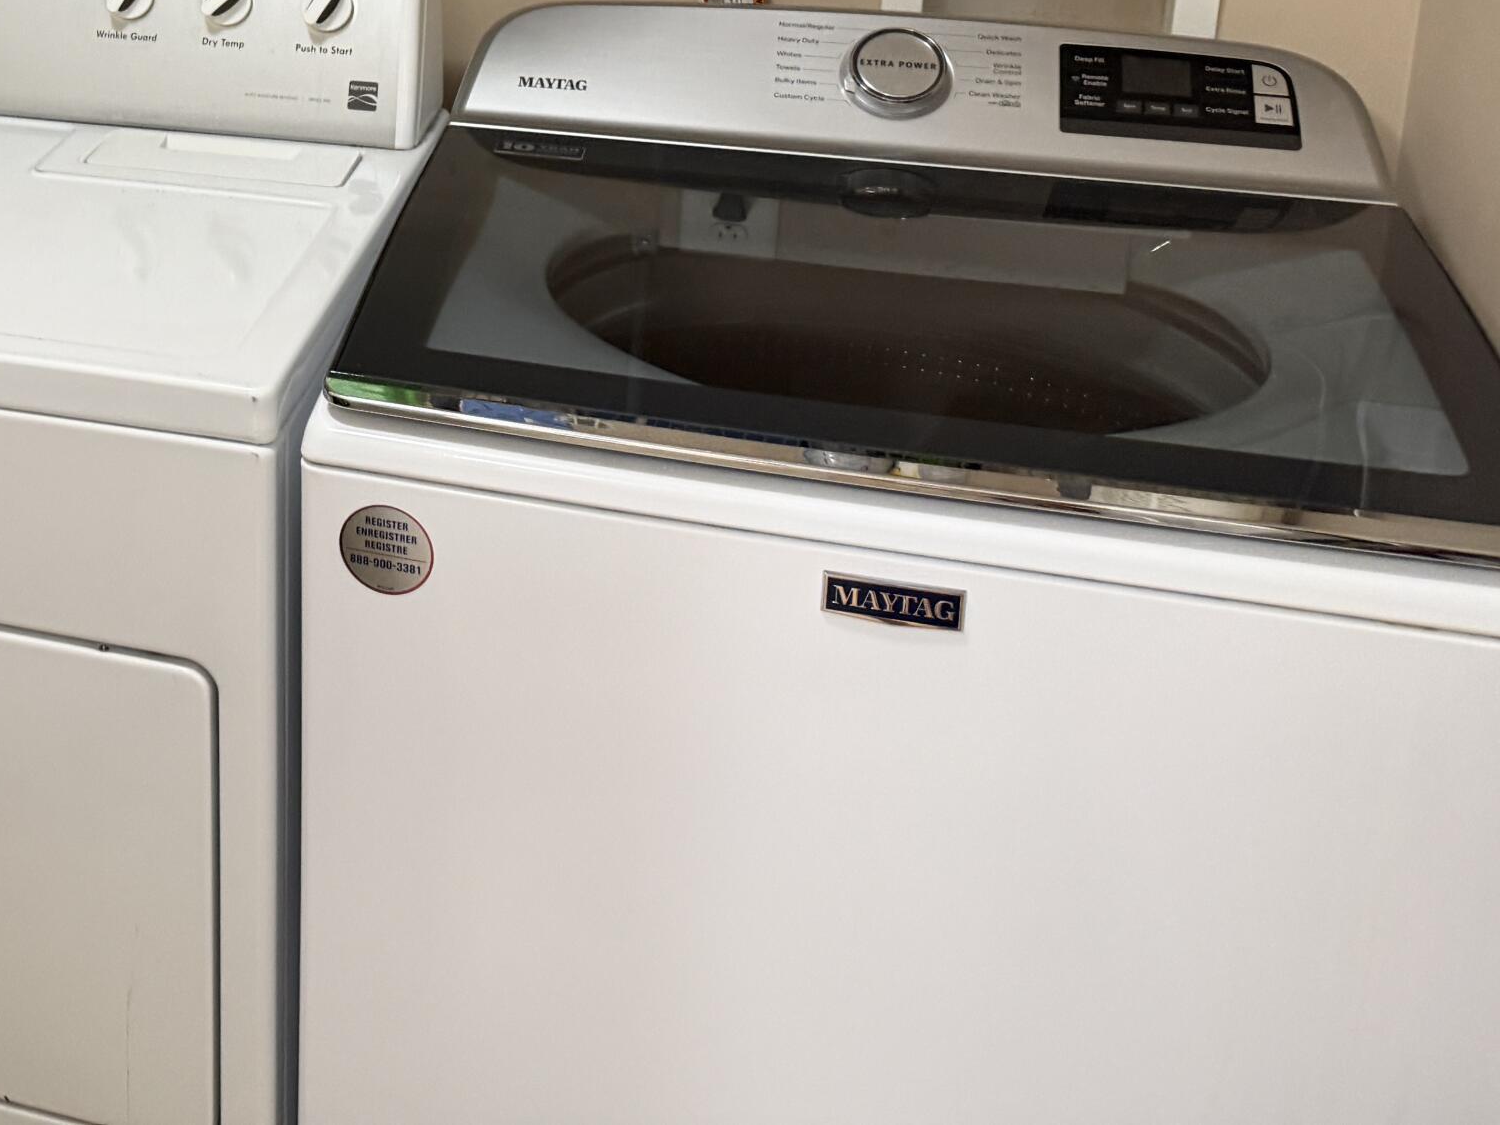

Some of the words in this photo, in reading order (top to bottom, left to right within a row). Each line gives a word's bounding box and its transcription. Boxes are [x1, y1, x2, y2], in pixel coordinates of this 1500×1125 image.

[778, 21, 835, 31] Normal/Regular
[96, 30, 128, 41] Wrinkle
[130, 31, 158, 42] Guard
[777, 36, 801, 44] Heavy
[802, 37, 820, 45] Duty
[202, 37, 218, 48] Dry
[220, 38, 245, 49] Temp
[295, 43, 317, 55] Push
[318, 45, 328, 55] to
[330, 46, 353, 56] Start
[776, 50, 802, 59] Whites
[860, 58, 894, 68] EXTRA
[898, 60, 937, 70] POWER
[1074, 55, 1094, 64] Deep
[776, 63, 802, 72] Towels
[1204, 65, 1226, 74] Delay
[517, 75, 588, 91] MAYTAG
[774, 76, 795, 85] Bulky
[796, 78, 818, 86] Items
[1082, 74, 1109, 82] Remote
[1205, 85, 1225, 93] Extra
[1226, 87, 1246, 95] Rinse
[773, 92, 803, 101] Custom
[804, 93, 825, 102] Cycle
[1205, 106, 1226, 114] Cycle
[365, 515, 409, 532] REGISTER
[356, 526, 417, 545] ENREGISTRER
[364, 539, 408, 555] REGISTRE
[350, 553, 422, 576] 888-900-3381
[831, 584, 955, 622] MAYTAG
